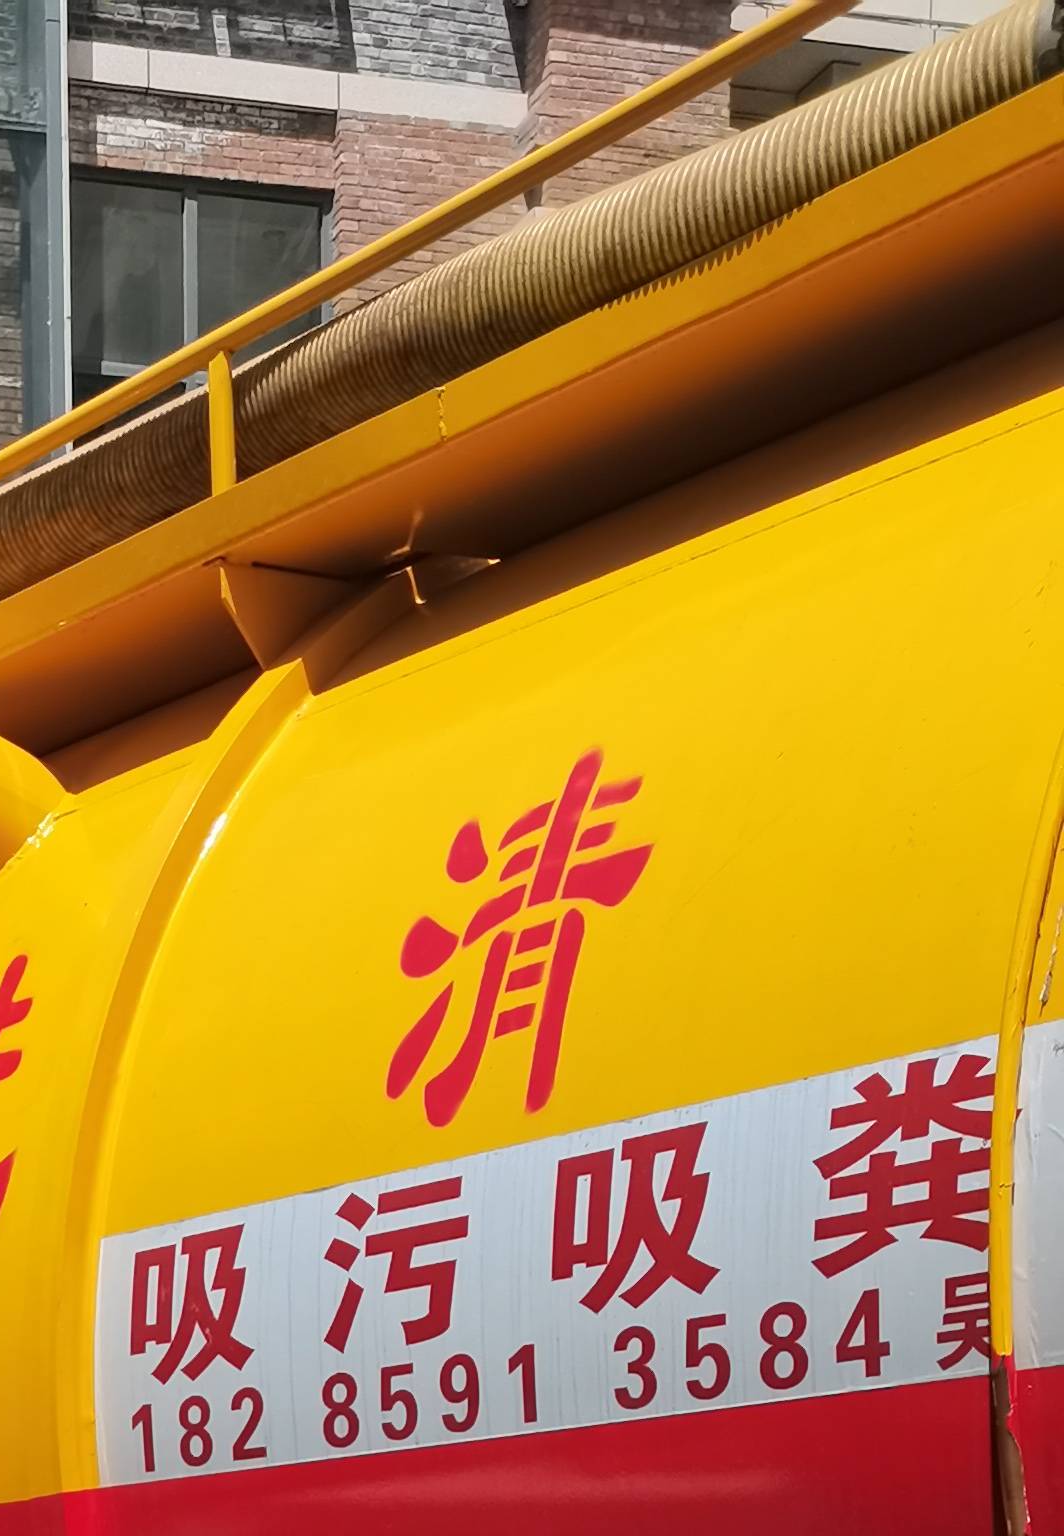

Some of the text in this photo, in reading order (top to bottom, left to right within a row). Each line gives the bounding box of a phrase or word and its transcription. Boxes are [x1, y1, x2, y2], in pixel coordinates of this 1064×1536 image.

[386, 747, 654, 1127] 清
[130, 1055, 996, 1384] 吸污吸粪
[133, 1271, 992, 1472] 182 8591 3584 吴
